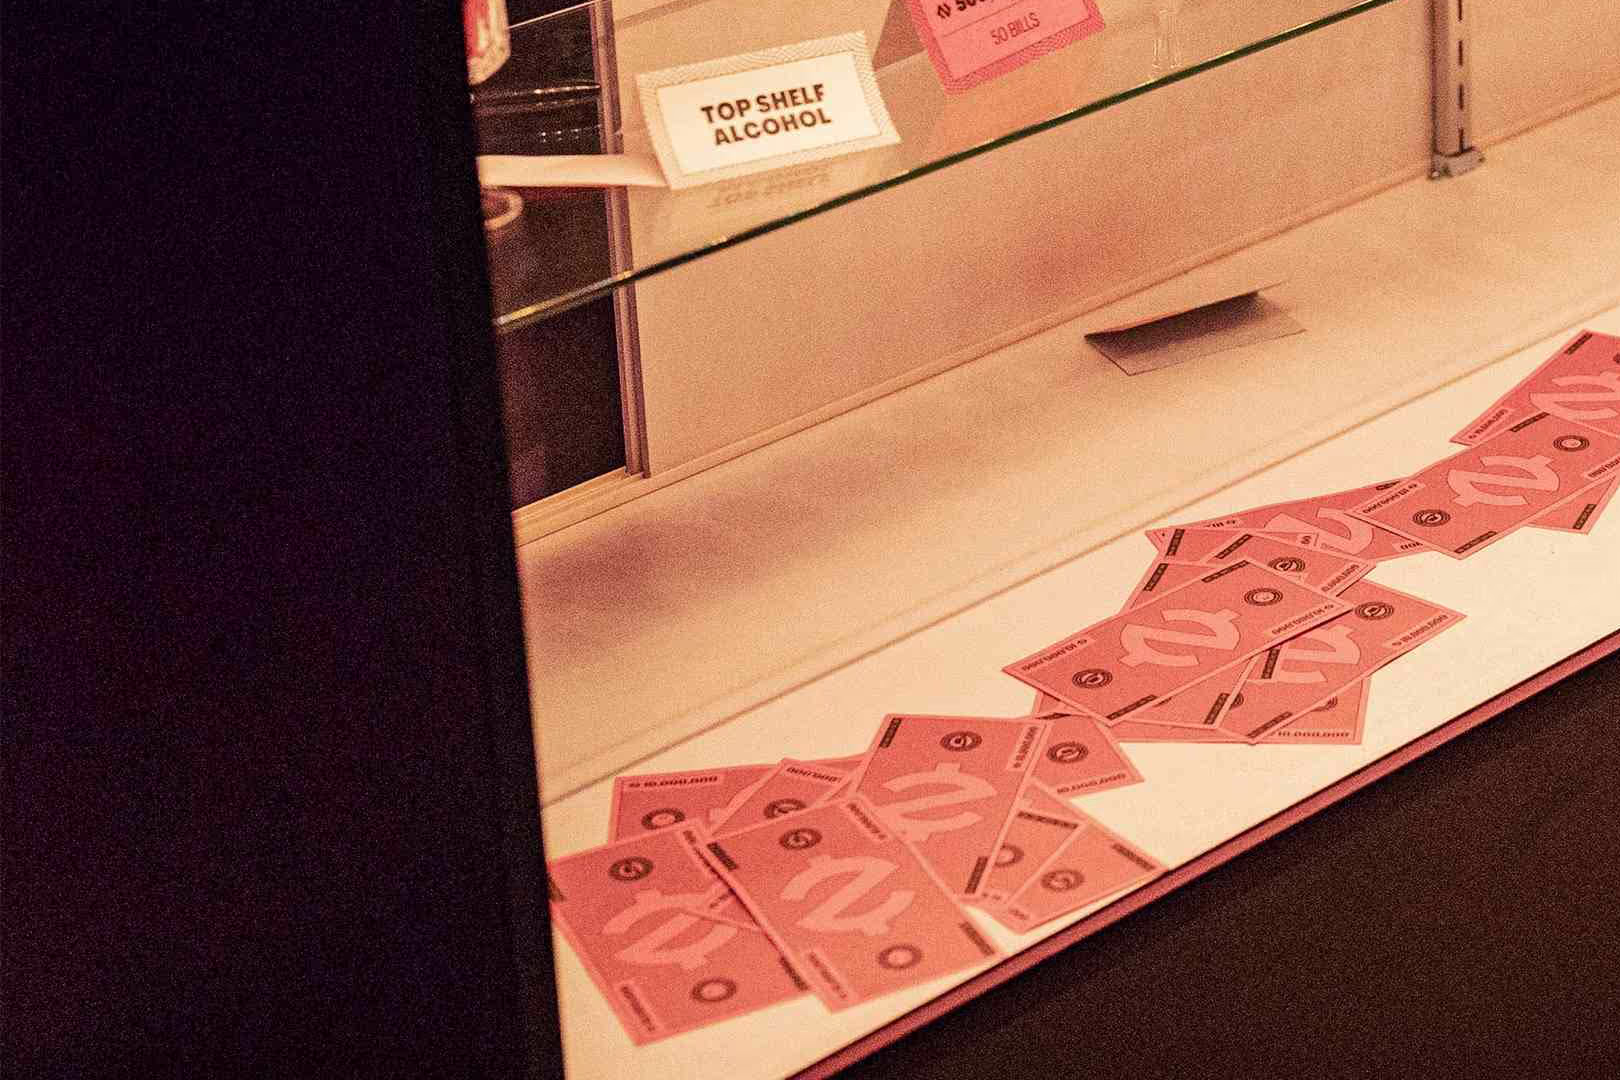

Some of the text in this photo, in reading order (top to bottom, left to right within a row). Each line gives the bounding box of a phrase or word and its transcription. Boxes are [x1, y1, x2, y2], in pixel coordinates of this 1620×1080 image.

[990, 12, 1041, 46] 50 BILLS
[700, 83, 825, 124] TOP SHELF
[715, 108, 832, 146] ALCOHOL
